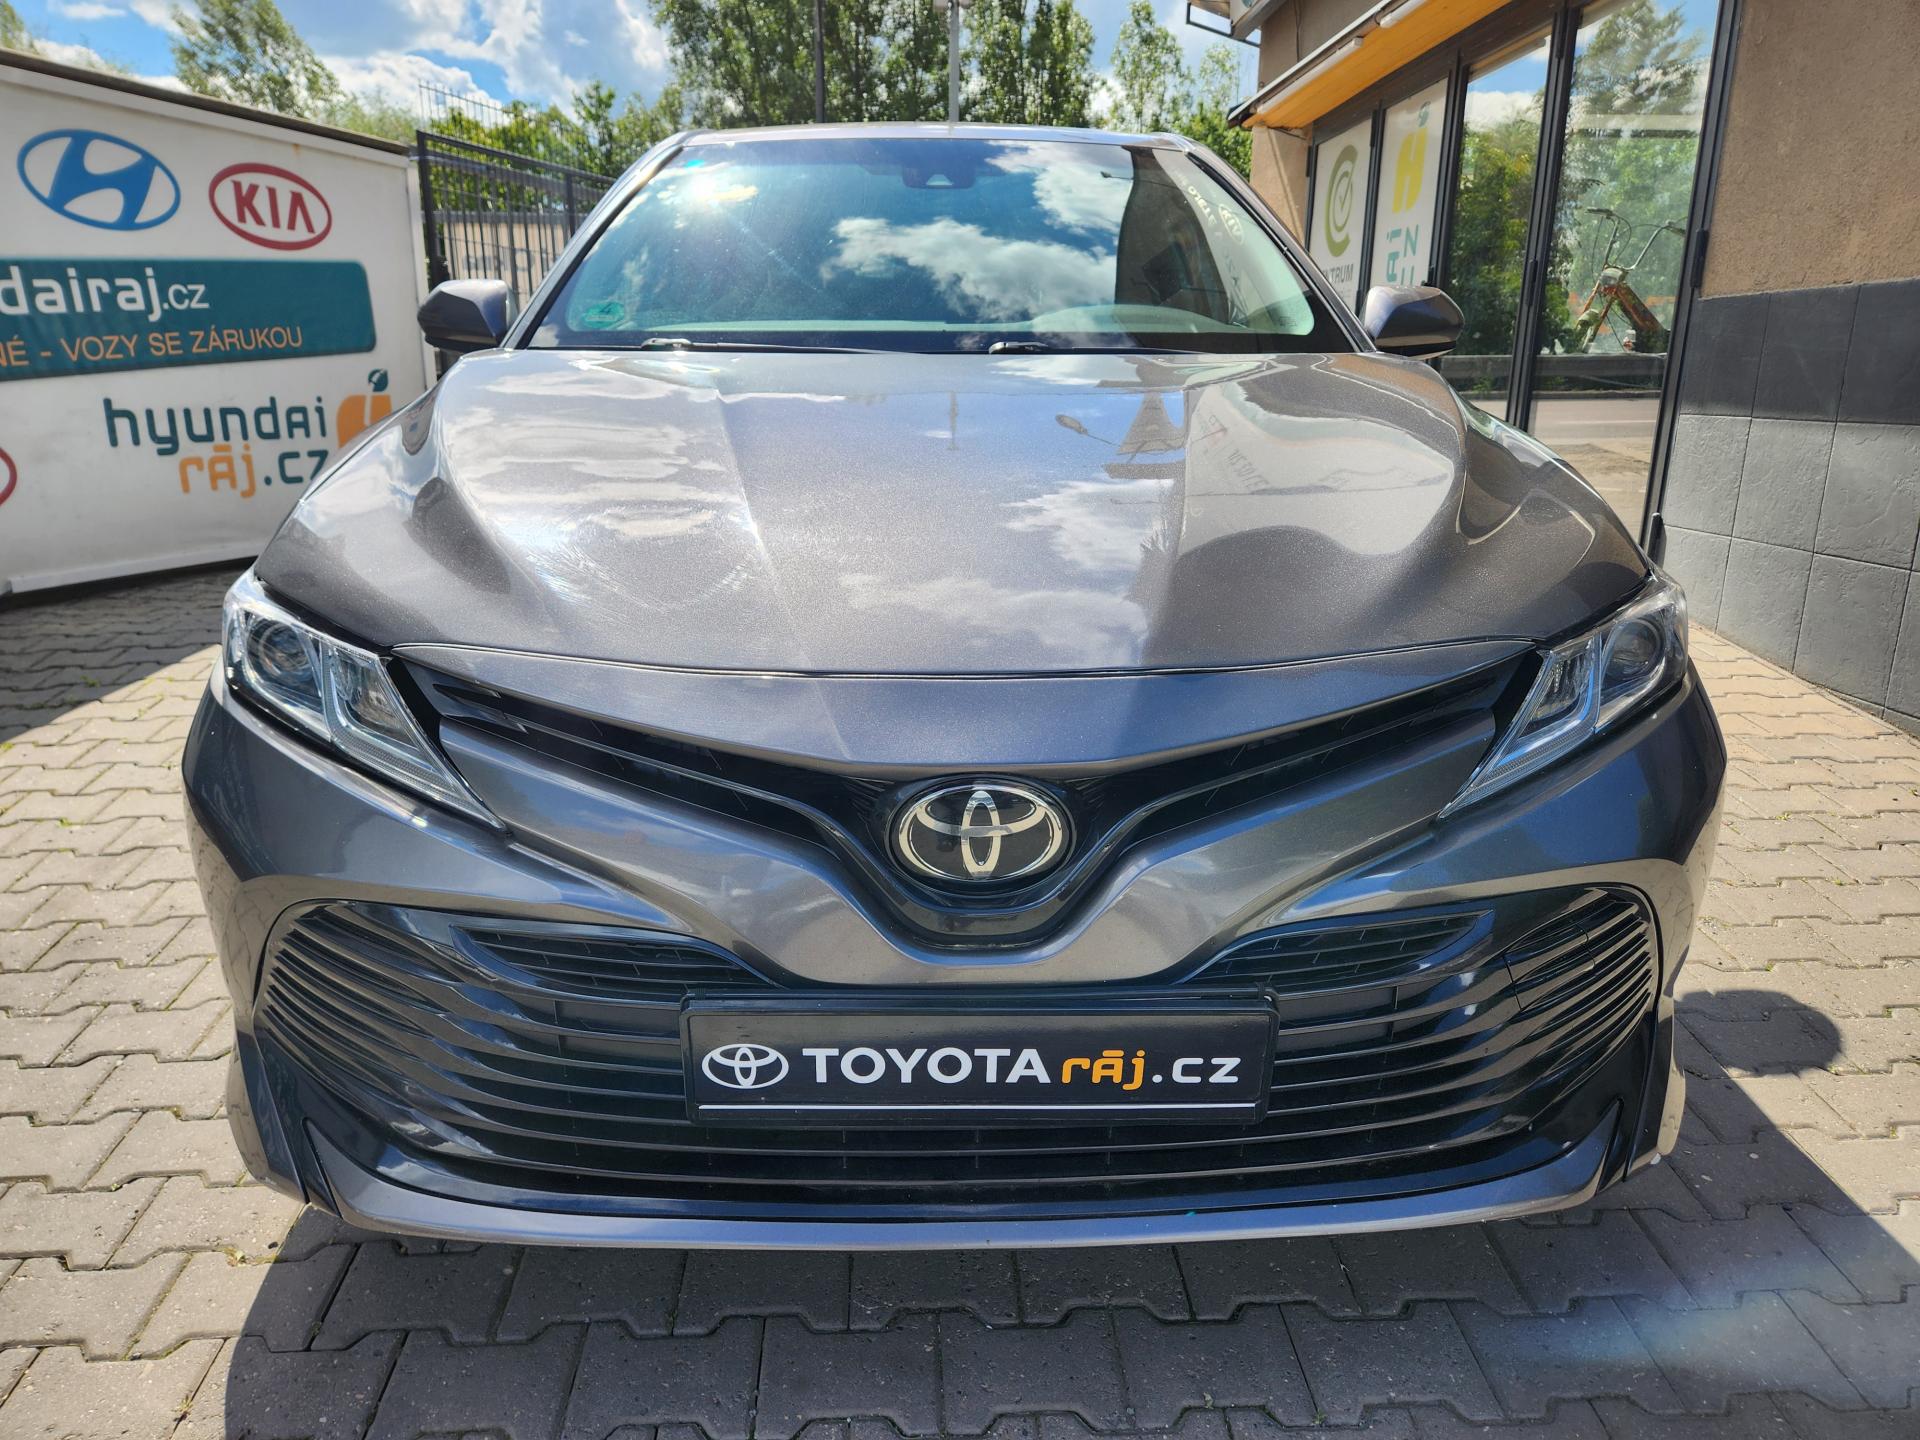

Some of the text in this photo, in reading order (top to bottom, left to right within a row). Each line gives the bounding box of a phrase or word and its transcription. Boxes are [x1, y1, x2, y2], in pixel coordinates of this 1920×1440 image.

[230, 180, 316, 234] KIA
[61, 335, 138, 361] VOZY
[149, 332, 183, 357] SE
[189, 324, 303, 354] ZÁRUKOU
[802, 1046, 1051, 1085] TOYOTA
